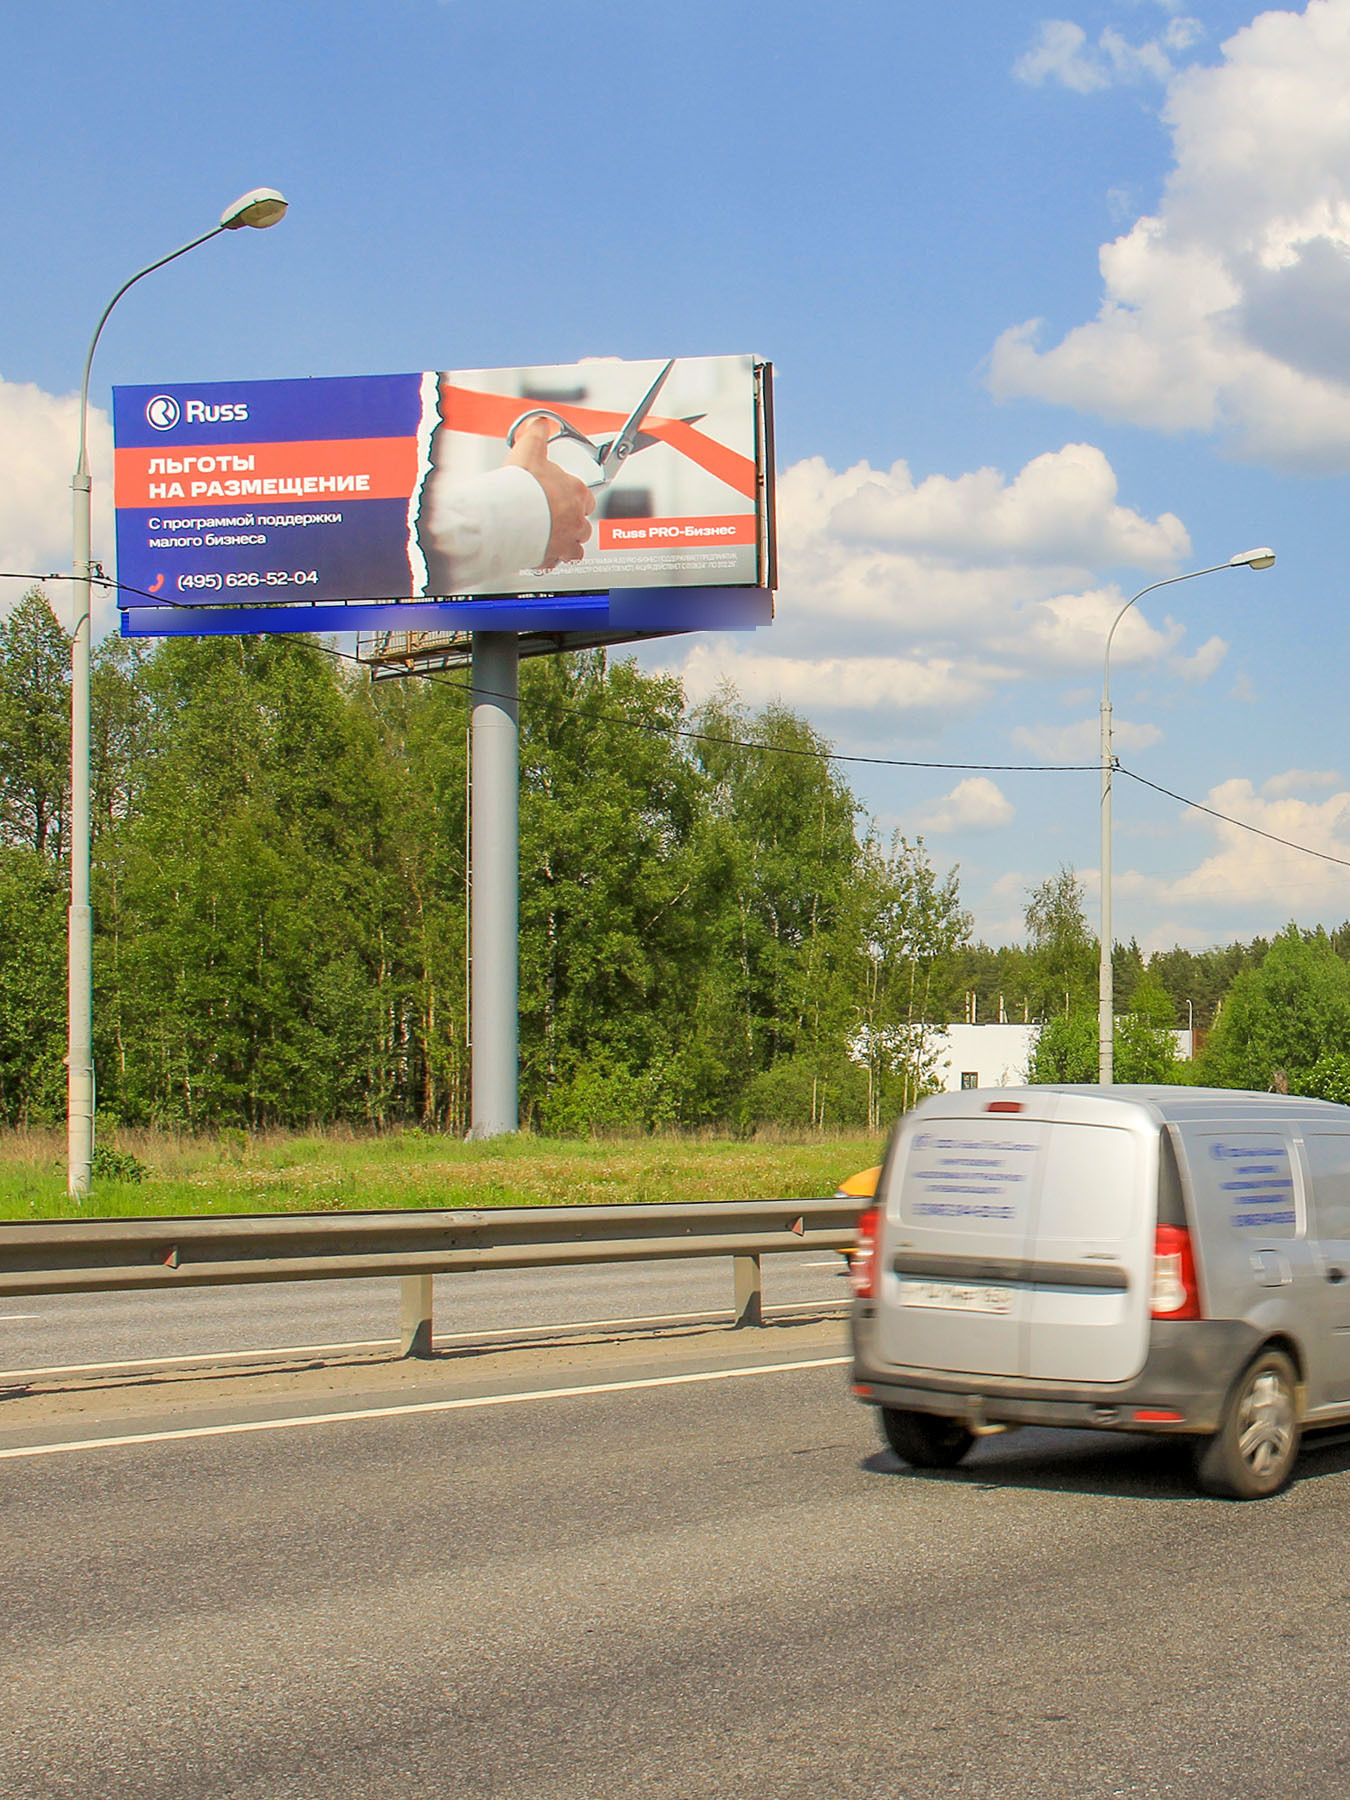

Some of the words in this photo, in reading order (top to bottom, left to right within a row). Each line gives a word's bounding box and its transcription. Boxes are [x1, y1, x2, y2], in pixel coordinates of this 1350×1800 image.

[186, 400, 248, 423] Russ
[148, 455, 255, 474] ЛЬГОТЫ
[149, 482, 185, 499] НА
[191, 475, 371, 496] РАЗМЕЩЕНИЕ
[149, 517, 161, 530] С
[163, 514, 255, 531] программой
[257, 512, 342, 527] поддержки
[149, 536, 203, 548] малого
[205, 533, 267, 546] бизнеса
[612, 528, 646, 539] Russ
[649, 525, 736, 538] PRO-Бизнес
[177, 572, 223, 591] (495)
[226, 570, 319, 588] 626-52-04
